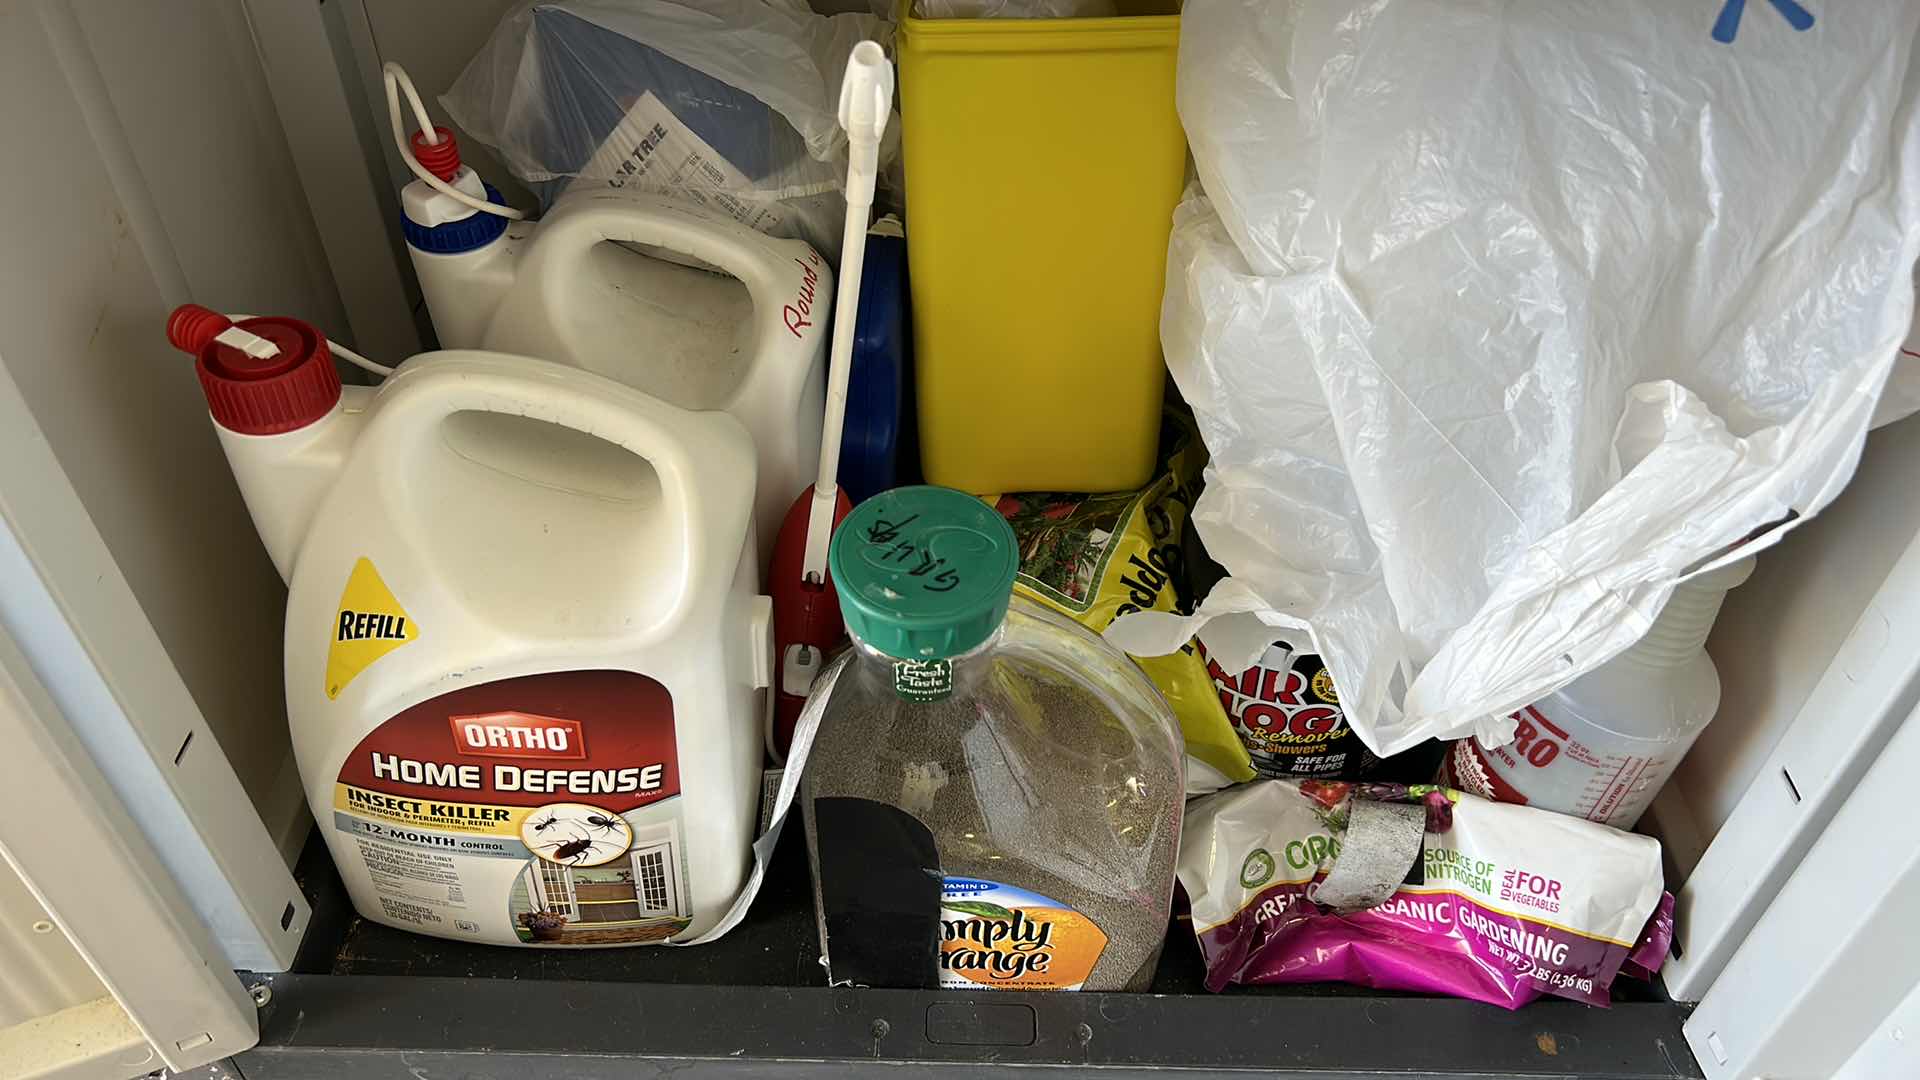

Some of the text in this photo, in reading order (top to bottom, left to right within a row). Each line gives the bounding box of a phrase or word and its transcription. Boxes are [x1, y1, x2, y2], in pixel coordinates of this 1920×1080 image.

[632, 122, 668, 162] TREE
[338, 610, 405, 641] REFILL
[900, 675, 943, 687] Taste
[903, 663, 945, 677] Fresh
[464, 724, 568, 751] ORTHO
[1252, 726, 1351, 744] Remover
[1509, 712, 1560, 768] RO
[371, 752, 663, 794] HOME DEFENSE
[1290, 764, 1312, 773] ALL
[1313, 761, 1344, 772] PIPES
[1295, 753, 1347, 765] SAFE FOR
[347, 788, 422, 813] INSECT
[430, 804, 511, 822] KILLER
[367, 804, 402, 817] INDOOR
[467, 819, 496, 827] REFILL
[362, 823, 456, 847] 12-MONTH
[460, 841, 505, 850] CONTROL
[1424, 849, 1495, 877] SOURCE OF
[1425, 864, 1492, 895] NITROGEN
[1500, 869, 1562, 901] IDEAL FOR
[1511, 891, 1560, 914] VEGETABLES
[941, 909, 1055, 952] mply
[1370, 898, 1569, 966] GANIC GARDENING
[941, 948, 1052, 980] range
[1488, 940, 1504, 958] NET
[1575, 977, 1593, 994] KG)
